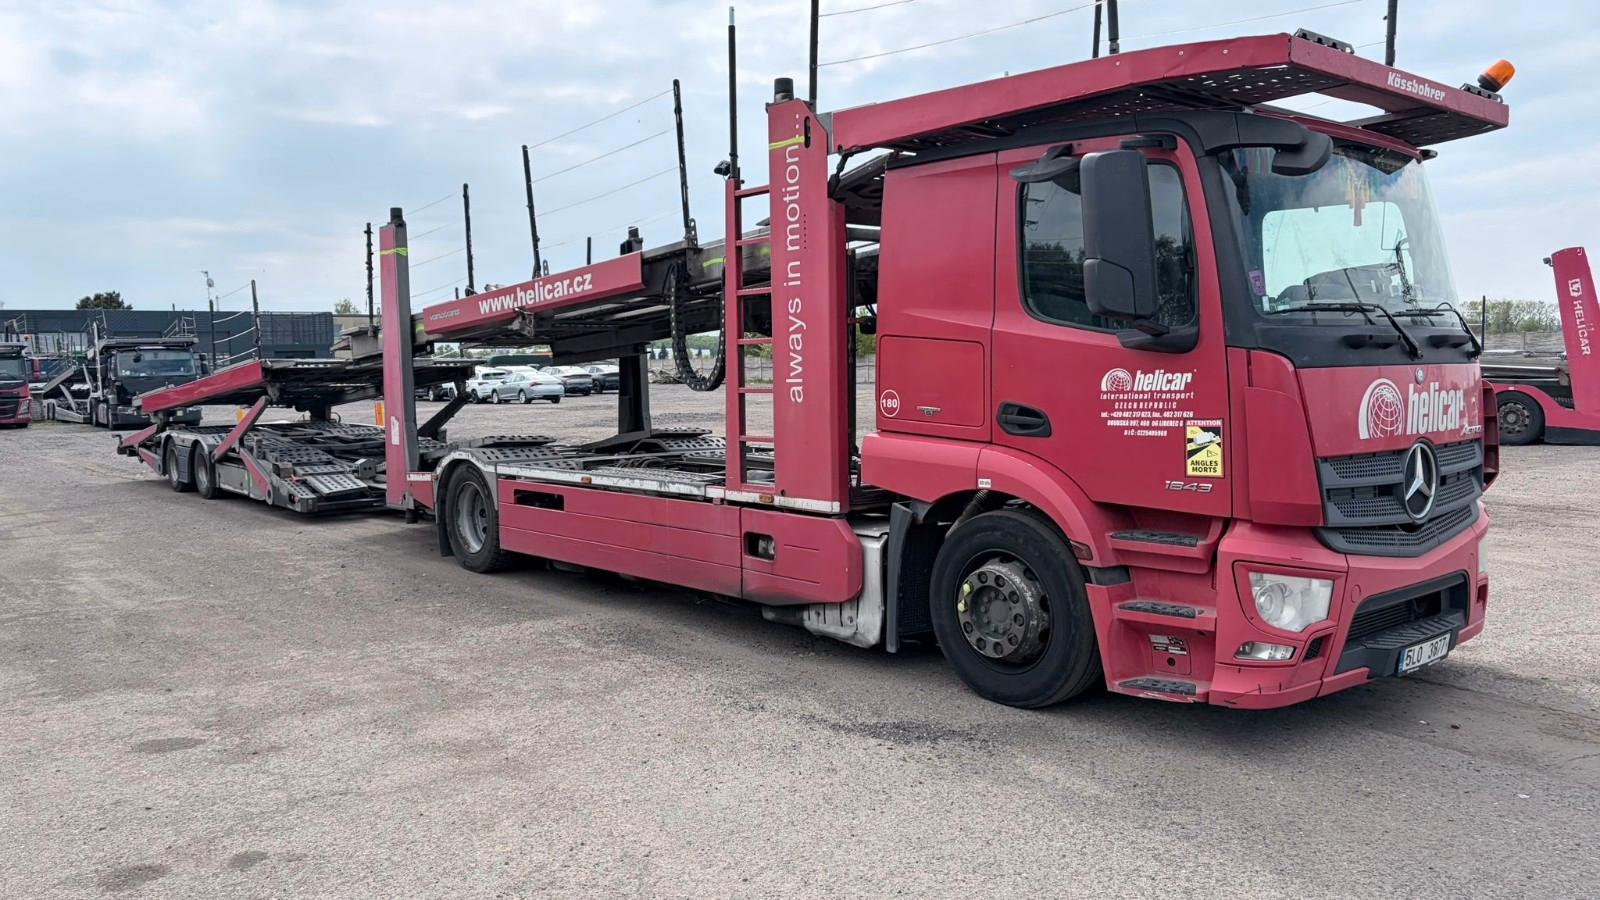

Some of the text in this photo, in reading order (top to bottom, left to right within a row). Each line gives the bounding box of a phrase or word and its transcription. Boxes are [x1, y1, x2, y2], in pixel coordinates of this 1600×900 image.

[1387, 71, 1446, 101] Kässbohrer
[784, 260, 801, 287] in
[478, 272, 593, 315] www.helicar.cz
[1573, 300, 1591, 356] HELICAR
[786, 297, 807, 403] always
[1133, 369, 1192, 391] helicar
[882, 398, 898, 408] 180
[1100, 392, 1194, 400] international transport
[1406, 382, 1464, 435] helicar
